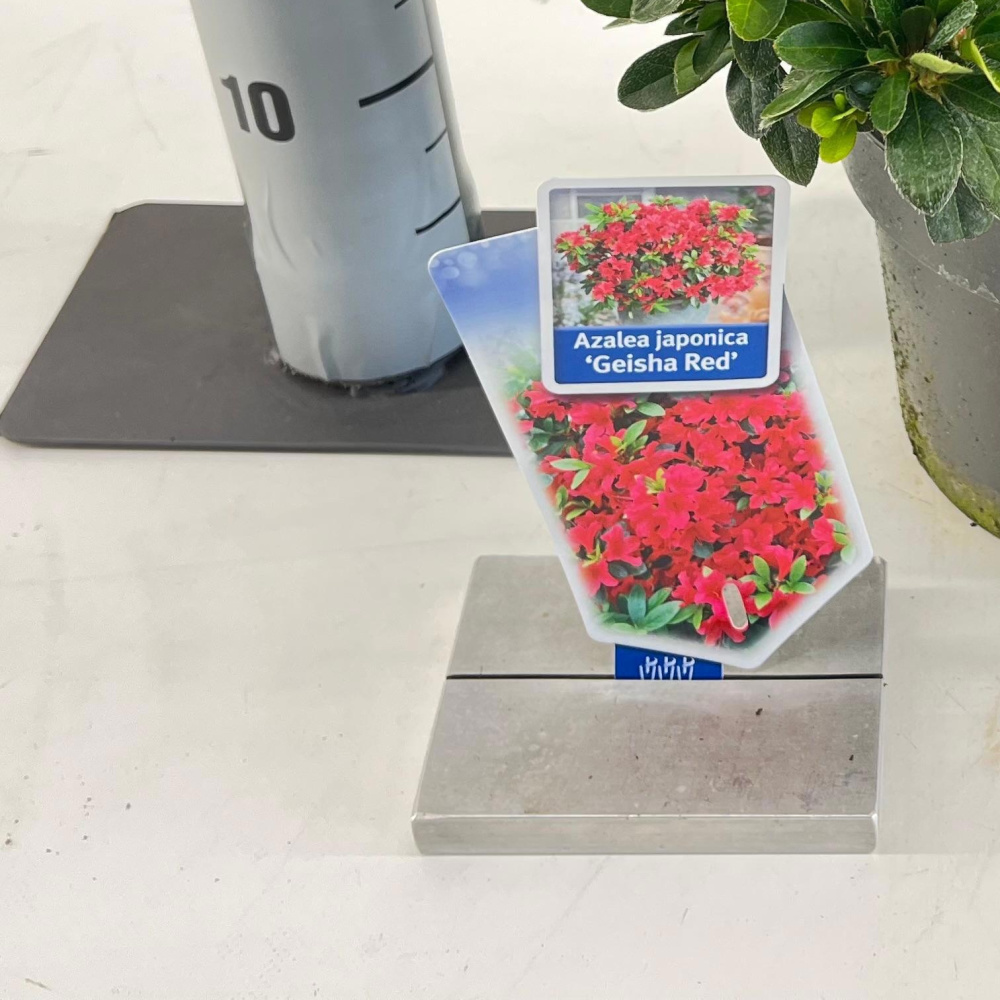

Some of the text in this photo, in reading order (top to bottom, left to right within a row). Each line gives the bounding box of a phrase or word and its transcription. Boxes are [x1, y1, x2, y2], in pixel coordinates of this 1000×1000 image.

[220, 74, 296, 143] 10
[574, 329, 749, 351] Azalea japonica
